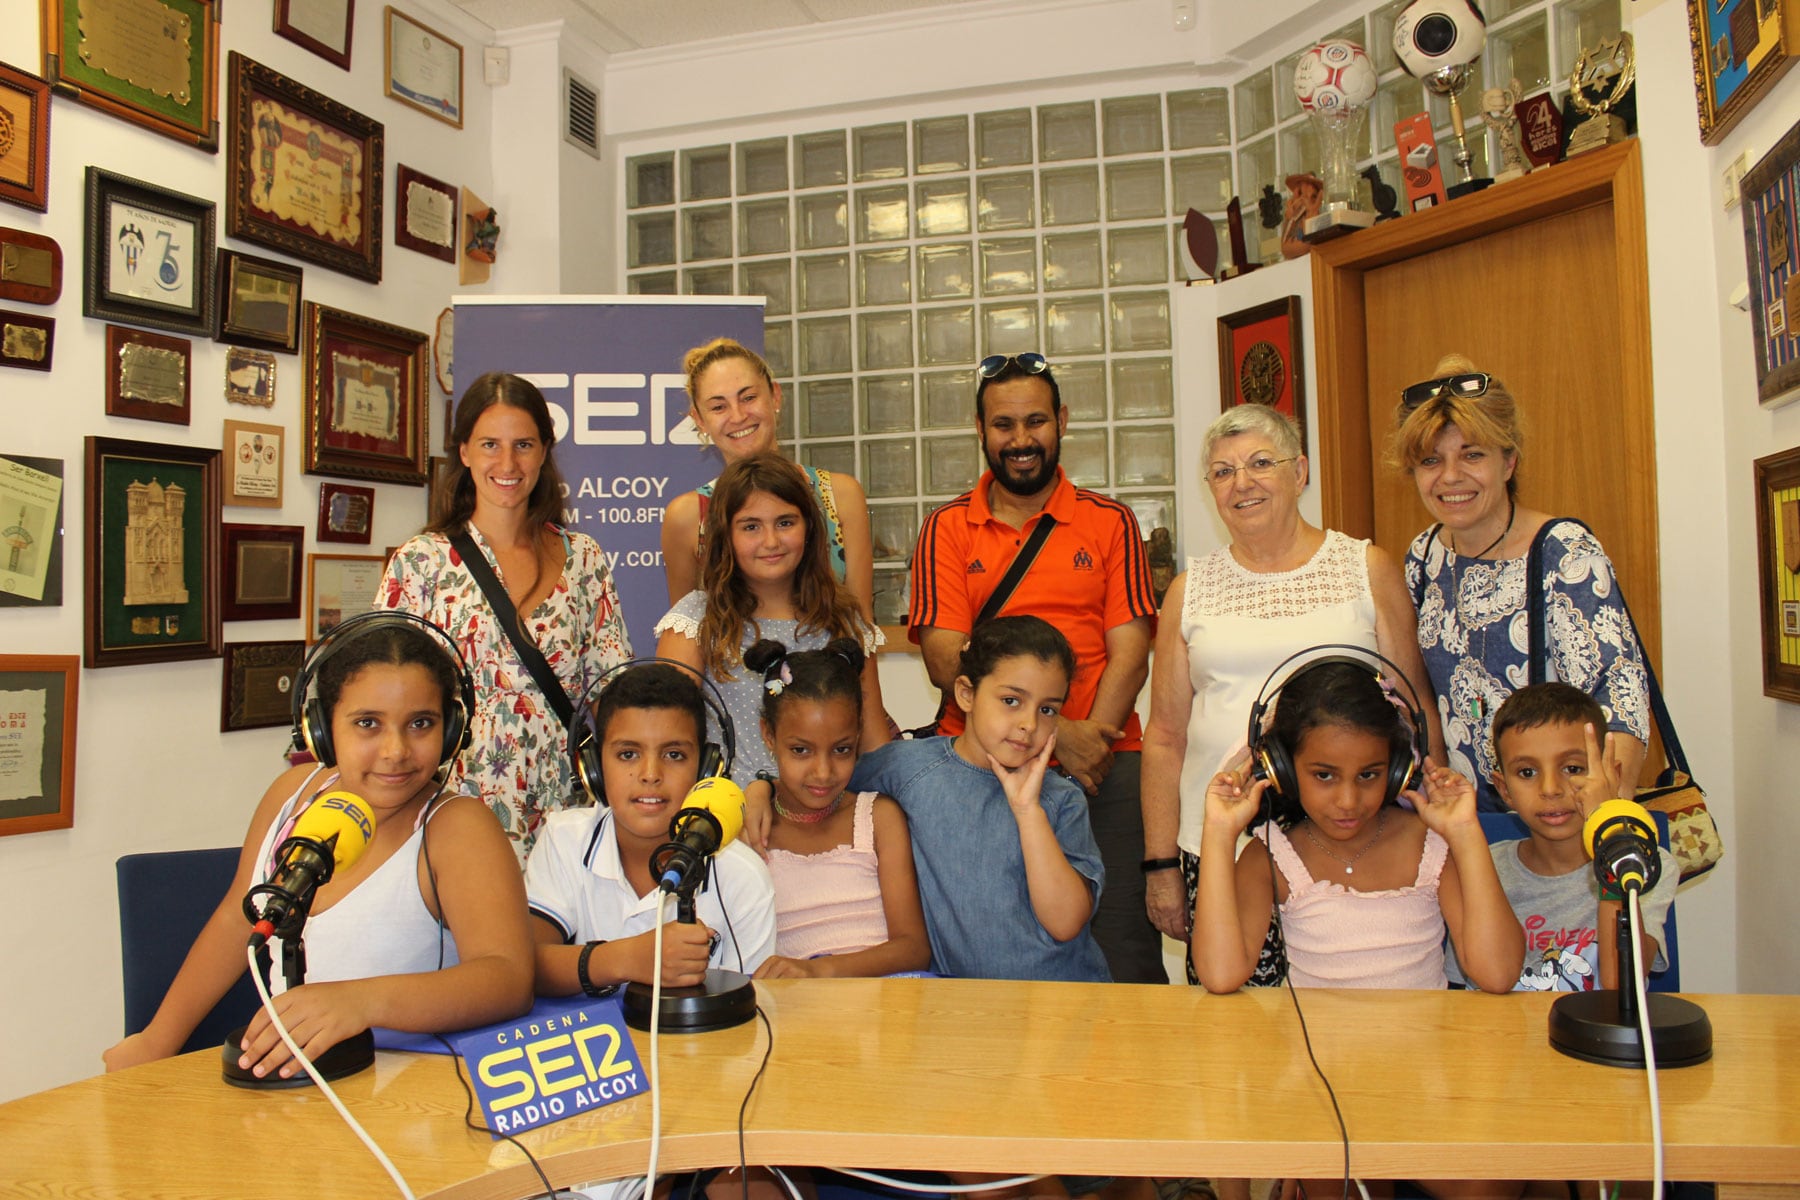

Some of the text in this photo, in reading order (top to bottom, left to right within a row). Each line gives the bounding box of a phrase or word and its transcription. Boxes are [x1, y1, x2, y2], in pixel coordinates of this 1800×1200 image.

[577, 477, 669, 498] ALCOY
[321, 798, 372, 845] SER
[497, 1011, 589, 1045] CADENA
[478, 1023, 633, 1113] SER
[494, 1073, 638, 1134] RADIO ALCOY
